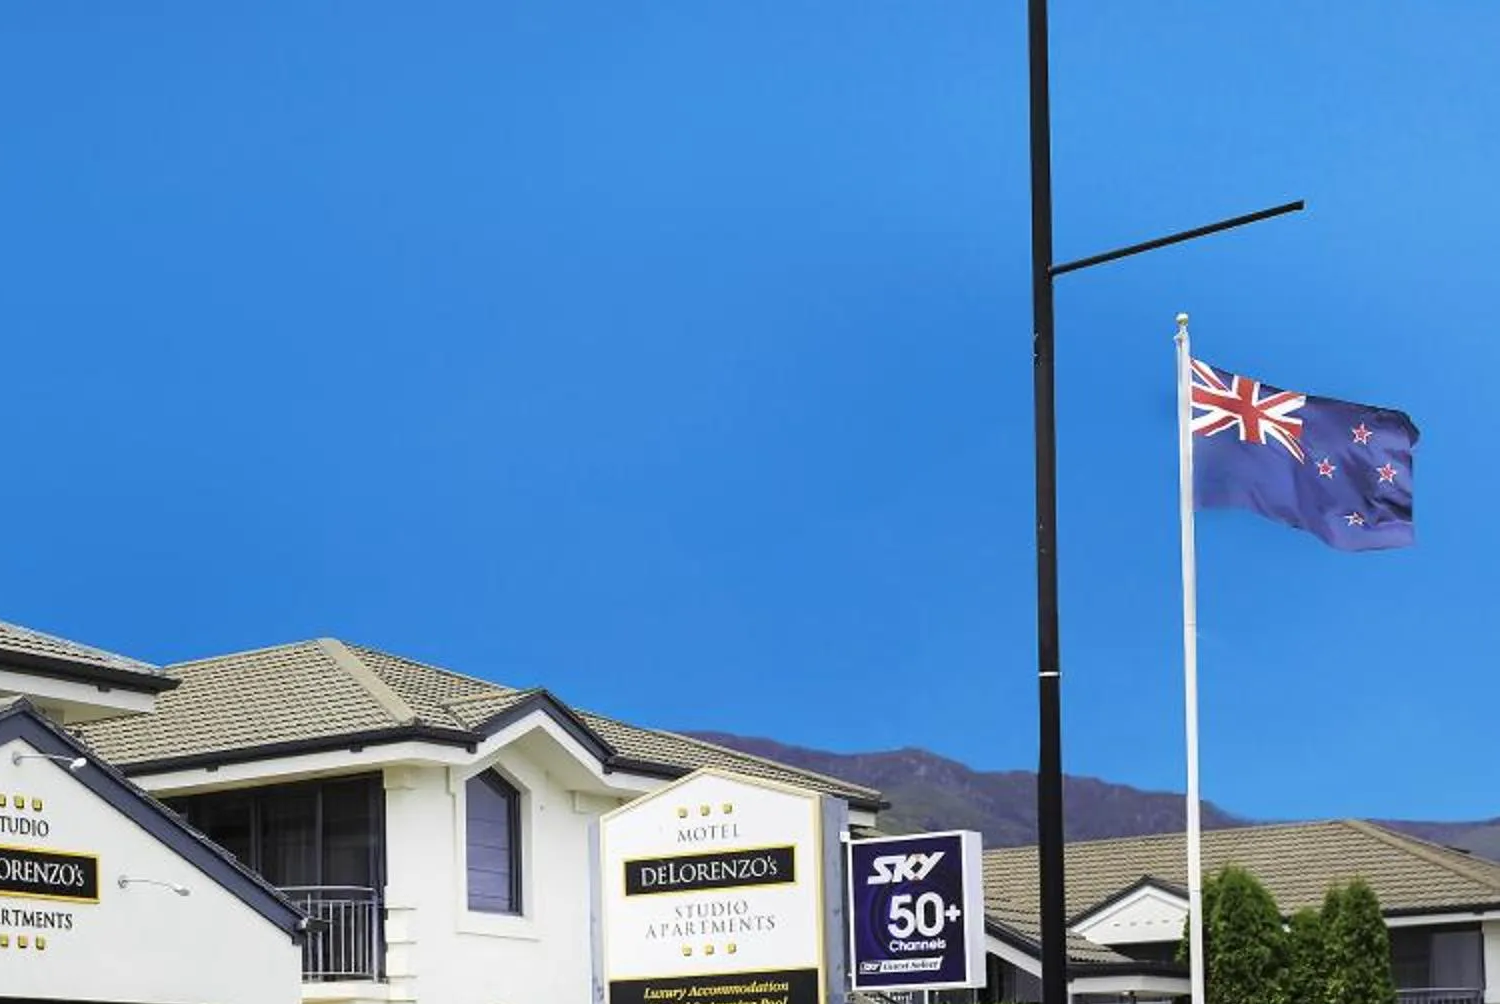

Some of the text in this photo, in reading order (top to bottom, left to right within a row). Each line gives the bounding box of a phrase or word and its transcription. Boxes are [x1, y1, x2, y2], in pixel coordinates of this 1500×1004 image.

[677, 823, 740, 842] MOTEL
[867, 852, 945, 884] SKY
[675, 899, 749, 919] STUDIO
[887, 891, 961, 938] 50+
[645, 915, 776, 939] APARTMENTS
[889, 938, 946, 953] Channels
[644, 987, 687, 1000] Luxury
